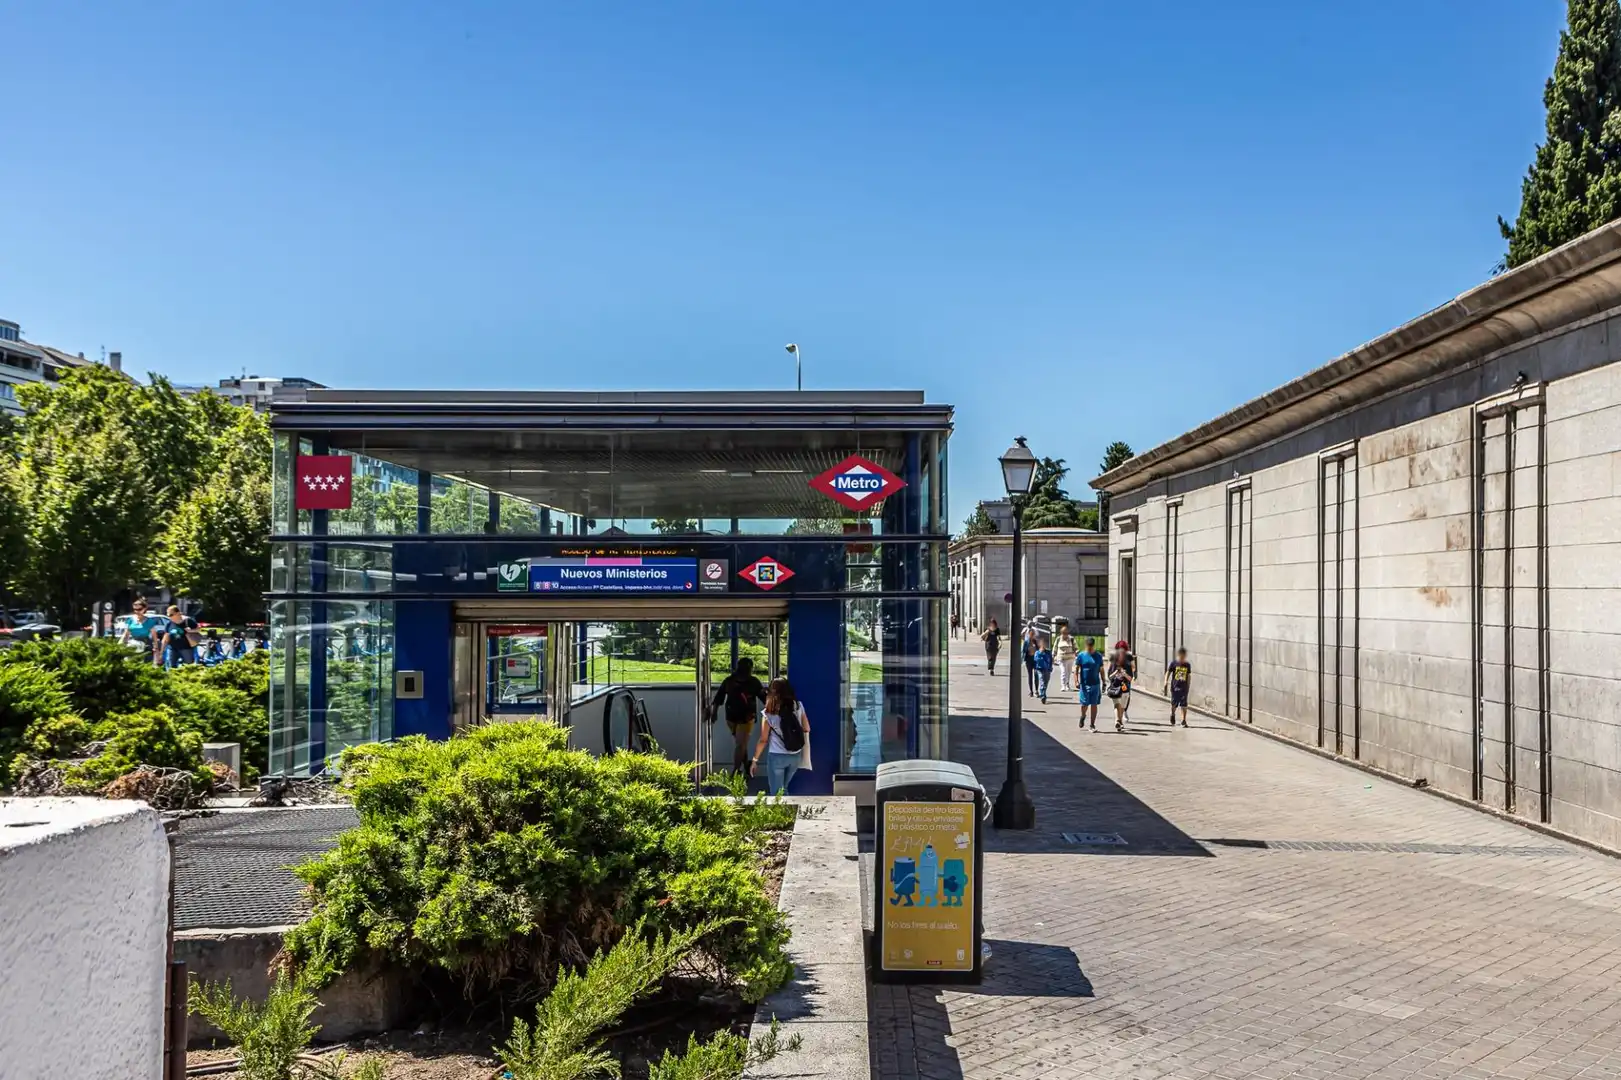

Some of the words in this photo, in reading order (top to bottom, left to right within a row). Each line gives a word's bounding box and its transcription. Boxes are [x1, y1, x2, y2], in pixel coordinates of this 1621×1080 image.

[838, 477, 879, 488] Metro
[560, 568, 603, 579] Nuevos
[605, 568, 668, 579] Ministerios
[551, 581, 559, 589] 10
[888, 805, 921, 815] Deposita
[888, 823, 898, 831] de
[887, 921, 899, 929] No
